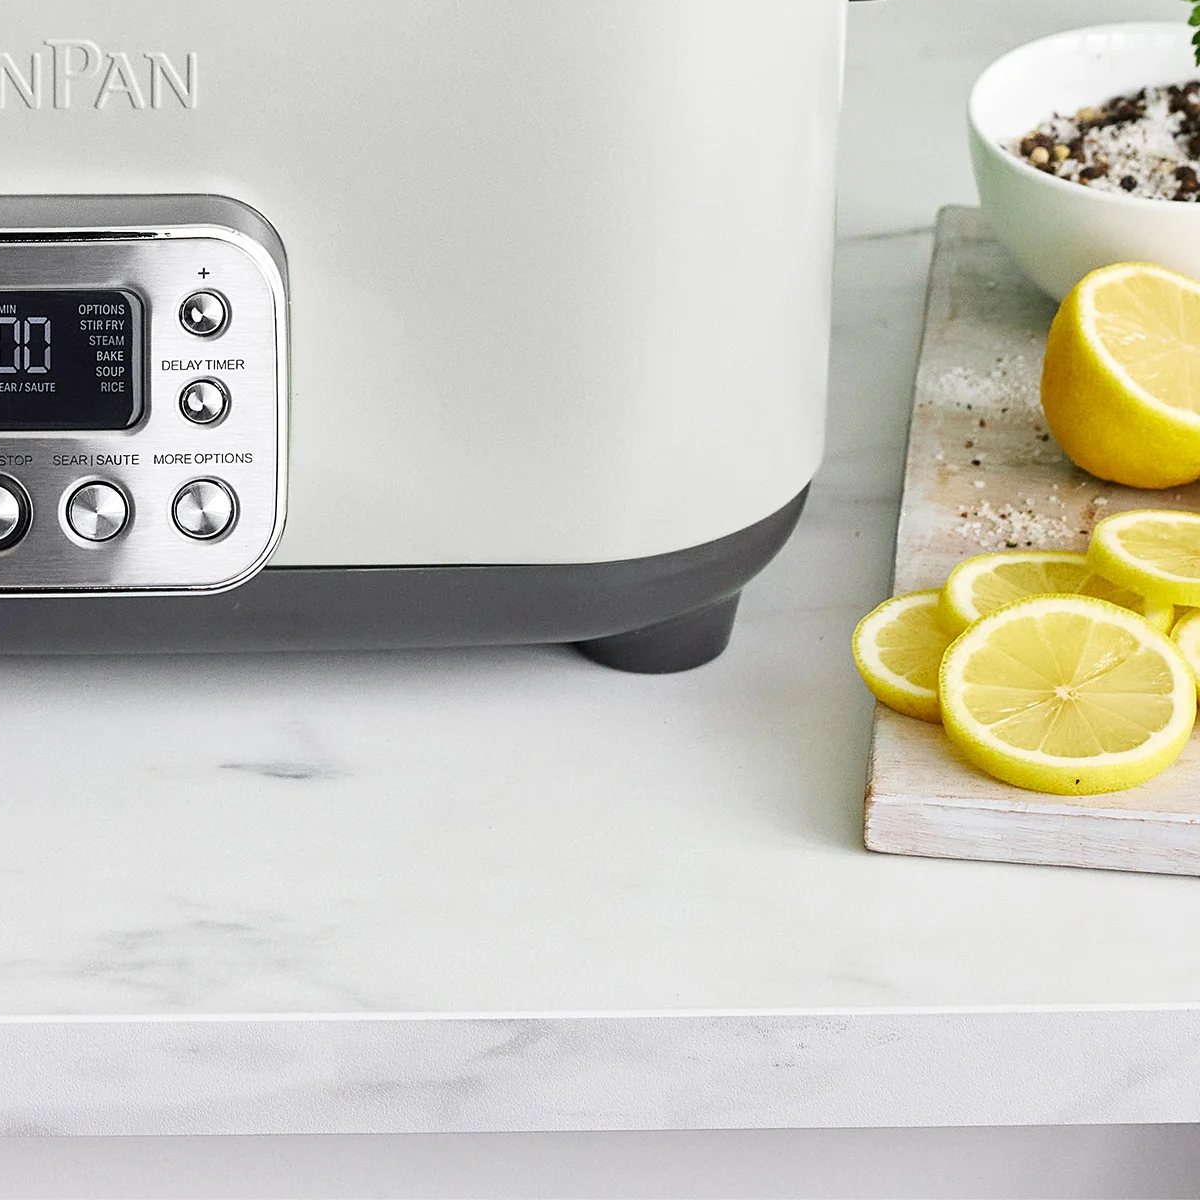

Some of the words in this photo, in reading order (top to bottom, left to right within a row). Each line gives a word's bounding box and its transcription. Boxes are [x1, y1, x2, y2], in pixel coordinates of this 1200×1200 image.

[78, 304, 126, 315] OPTIONS
[79, 320, 103, 331] STIR
[105, 320, 126, 331] FRY
[88, 335, 125, 346] STEAM
[96, 350, 125, 362] BAKE
[161, 359, 202, 371] DELAY
[204, 359, 245, 370] TIMER
[95, 366, 125, 378] SOUP
[24, 382, 56, 393] SAUTE
[100, 382, 125, 393] RICE
[52, 454, 87, 466] SEAR
[96, 454, 140, 466] SAUTE
[153, 453, 192, 465] MORE
[194, 452, 253, 464] OPTIONS
